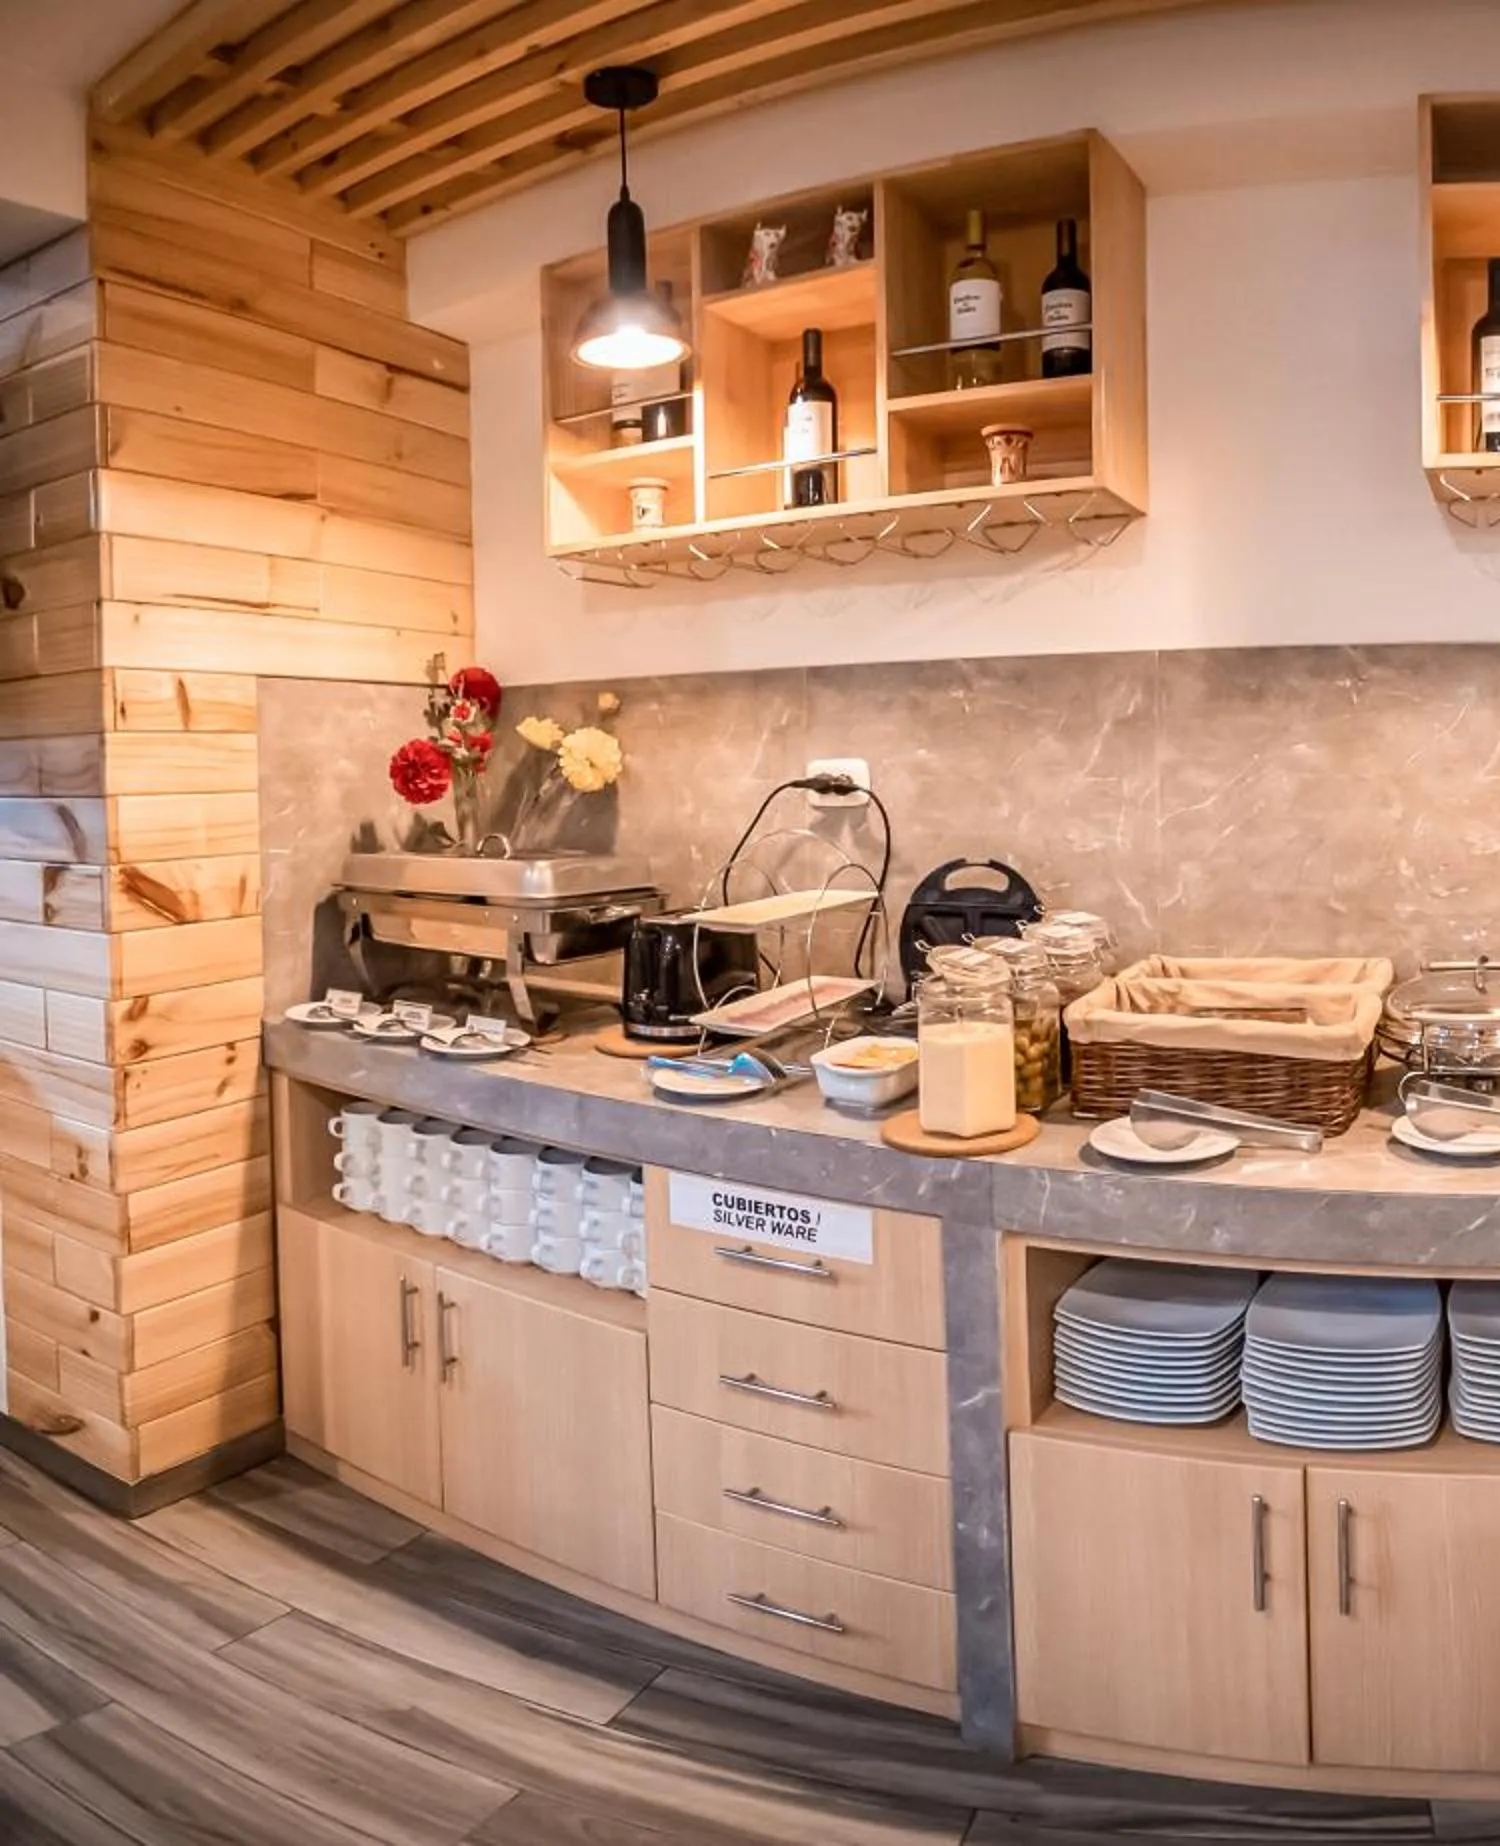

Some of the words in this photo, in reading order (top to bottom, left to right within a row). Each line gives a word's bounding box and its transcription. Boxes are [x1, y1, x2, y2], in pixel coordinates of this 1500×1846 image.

[712, 1192, 811, 1225] CUBIERTOS
[815, 1211, 822, 1227] /
[713, 1209, 766, 1232] SILVER
[770, 1220, 819, 1243] WARE
